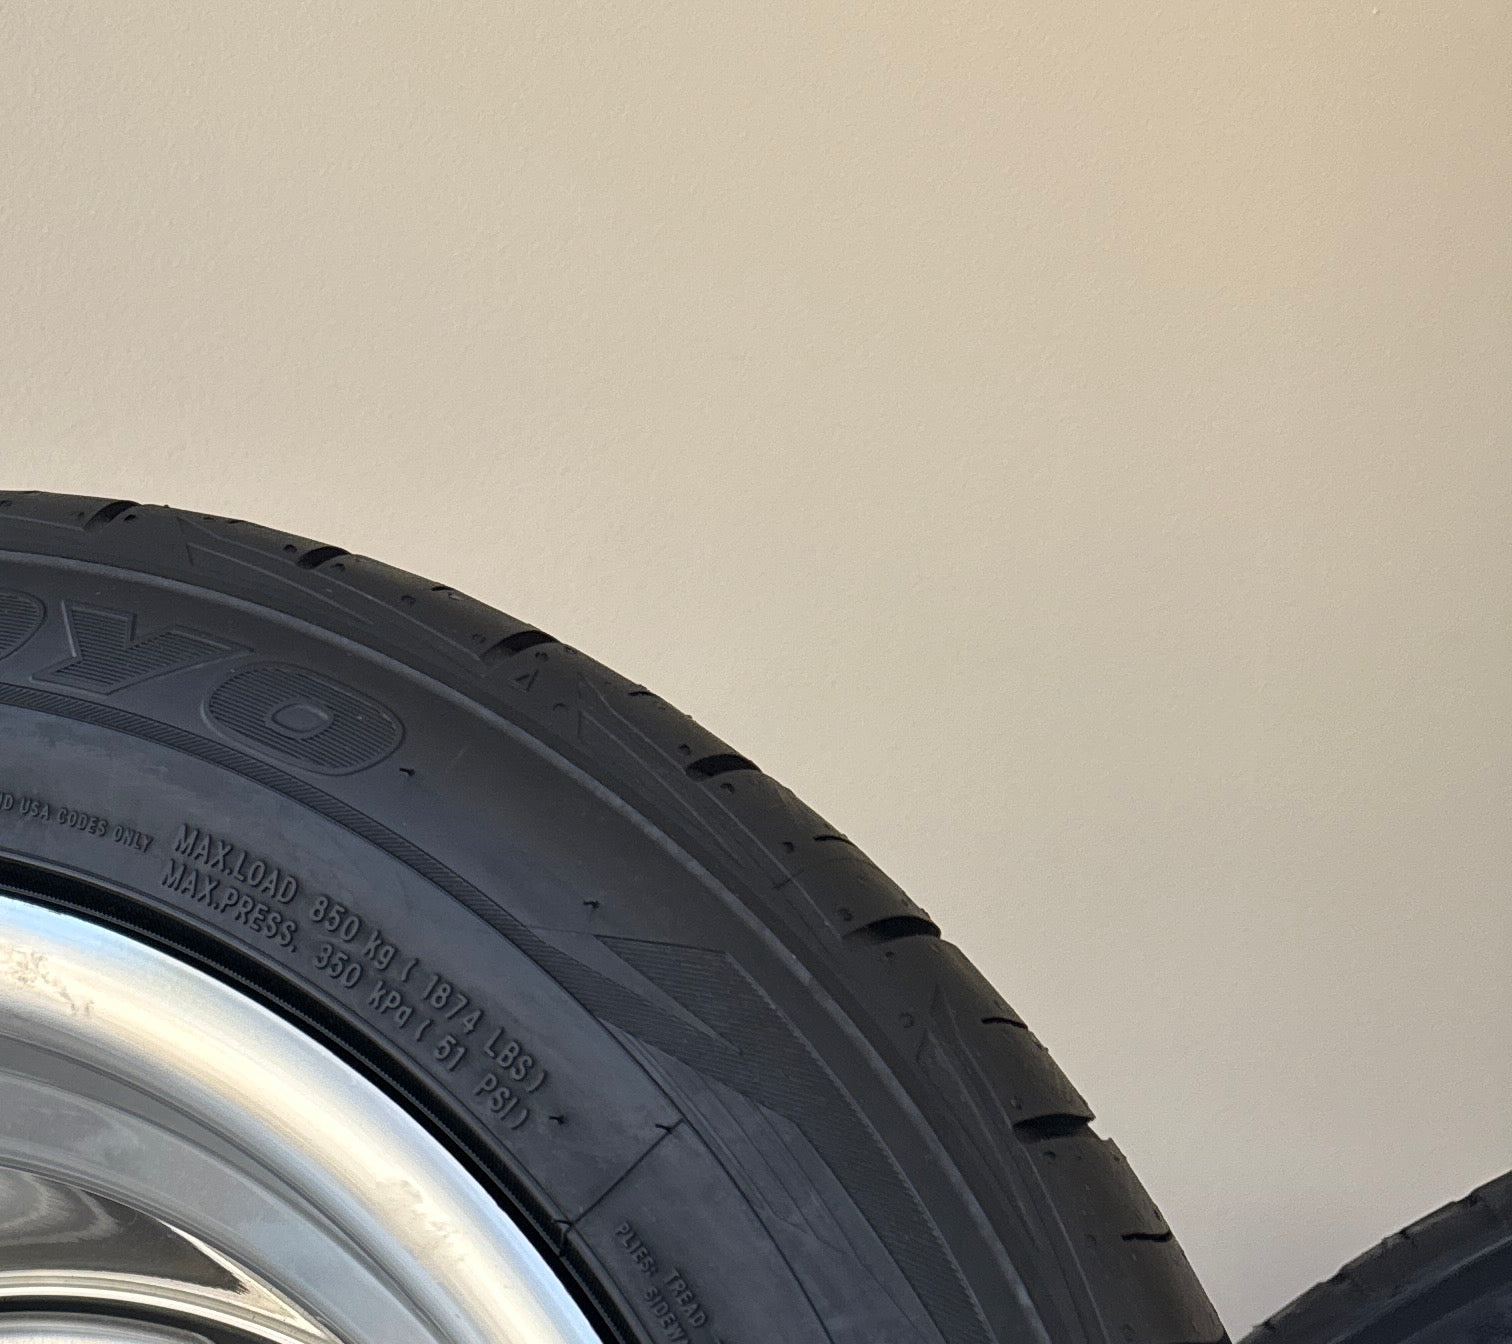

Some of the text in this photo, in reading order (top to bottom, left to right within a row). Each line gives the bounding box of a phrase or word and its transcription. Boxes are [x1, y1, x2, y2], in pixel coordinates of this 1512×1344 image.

[17, 794, 51, 820] USA
[57, 804, 109, 838] CODES
[113, 821, 156, 854] ONLY
[170, 821, 300, 911] MAX.LOAD
[306, 889, 363, 946] 850
[358, 927, 399, 973] kg
[311, 939, 365, 993] 350
[364, 976, 415, 1032] kPa
[662, 1266, 710, 1333] TREAD
